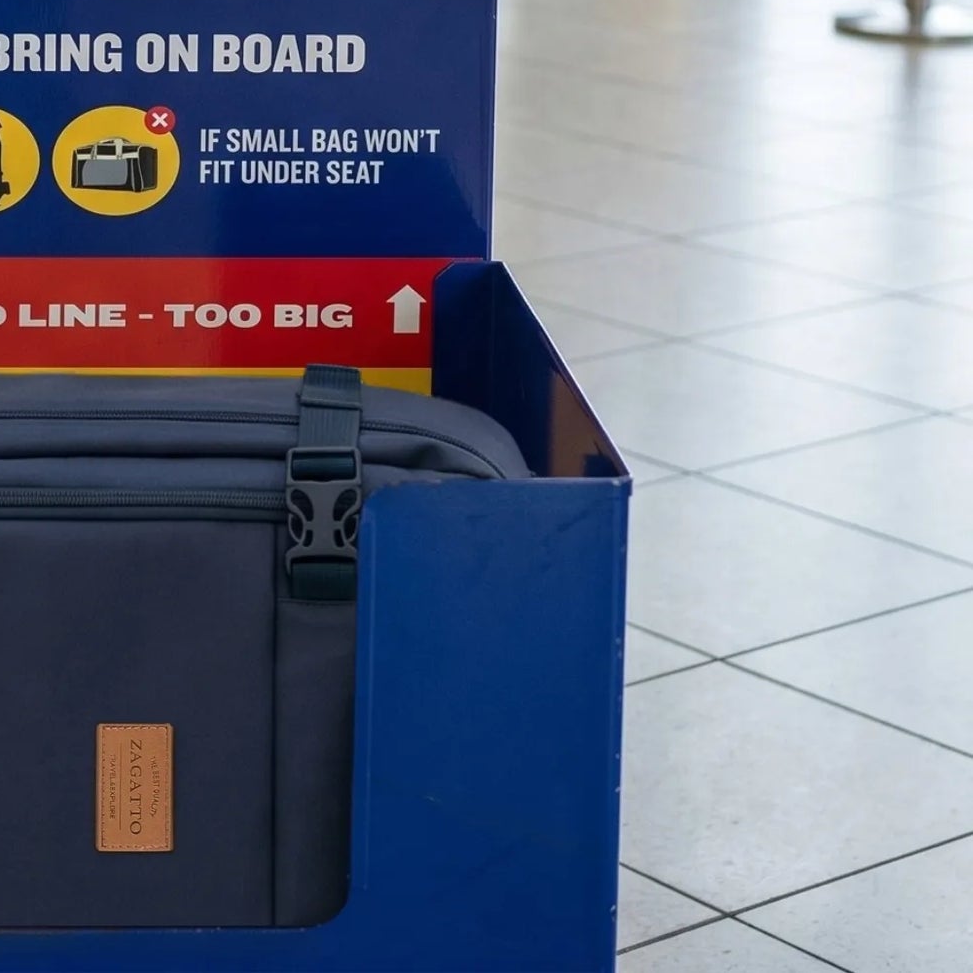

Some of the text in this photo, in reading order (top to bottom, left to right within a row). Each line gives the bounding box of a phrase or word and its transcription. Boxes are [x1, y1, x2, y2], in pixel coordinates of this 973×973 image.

[136, 33, 199, 73] ON
[212, 33, 366, 73] BOARD
[200, 128, 441, 153] IF SMALL BAG WON'T
[200, 160, 384, 184] FIT UNDER SEAT
[19, 303, 126, 328] LINE
[164, 302, 262, 328] TOO
[274, 303, 353, 328] BIG
[130, 739, 142, 835] ZAGATTO
